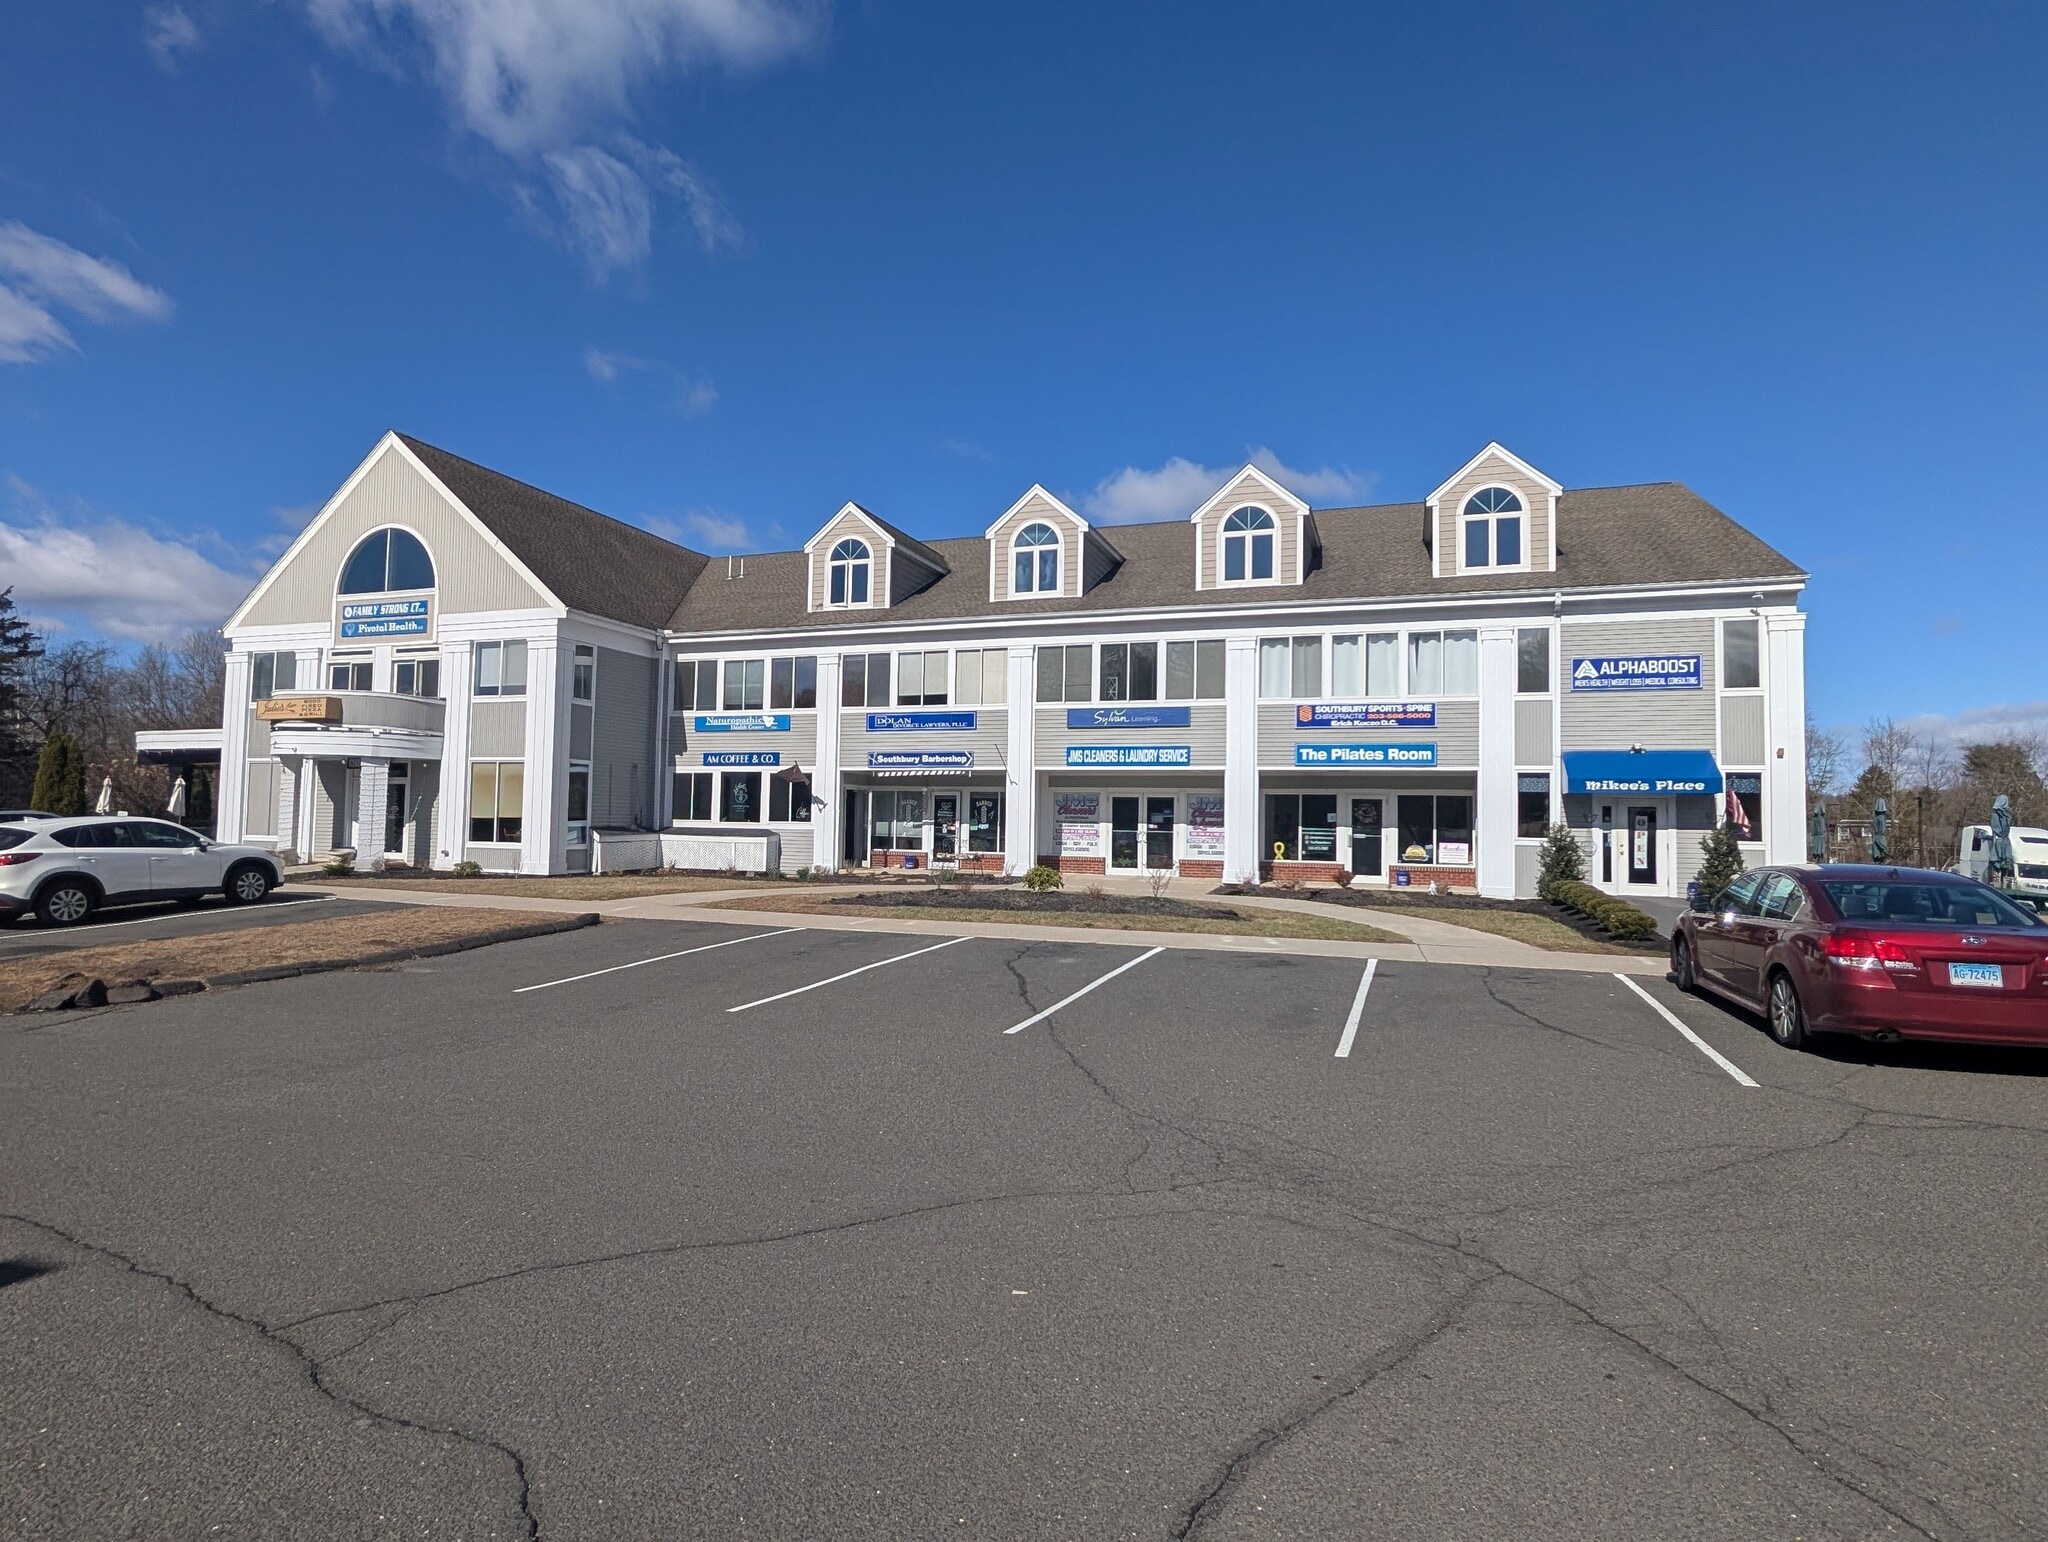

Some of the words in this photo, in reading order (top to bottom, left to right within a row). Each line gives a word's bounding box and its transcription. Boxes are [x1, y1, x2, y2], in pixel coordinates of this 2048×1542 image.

[353, 605, 379, 617] FAMILY
[380, 603, 409, 615] STRONG
[410, 602, 421, 613] CT
[358, 623, 388, 634] Pivotal
[388, 620, 418, 632] Health
[1600, 659, 1698, 675] ALPHABOOST
[1315, 704, 1367, 713] SOUTHBURY
[706, 716, 763, 725] Naturopathic
[876, 716, 912, 725] DOLAN
[1094, 709, 1130, 725] Sylvan
[1131, 715, 1159, 723] Learning
[706, 755, 719, 764] AM
[720, 754, 750, 764] COFFEE
[752, 754, 760, 764] &
[761, 754, 776, 764] CO.
[877, 754, 920, 764] Southbury
[921, 754, 968, 764] Barbershop
[1068, 749, 1083, 763] JMS
[1083, 749, 1119, 763] CLEANERS
[1119, 749, 1125, 763] &
[1125, 749, 1159, 763] LAUNDRY
[1158, 748, 1189, 763] SERVICE
[1299, 748, 1328, 761] The
[1331, 748, 1385, 761] Pilates
[1387, 748, 1433, 761] Room
[1655, 780, 1706, 791] Place
[1636, 817, 1646, 866] OPEN
[1953, 968, 1999, 981] AG-72475
